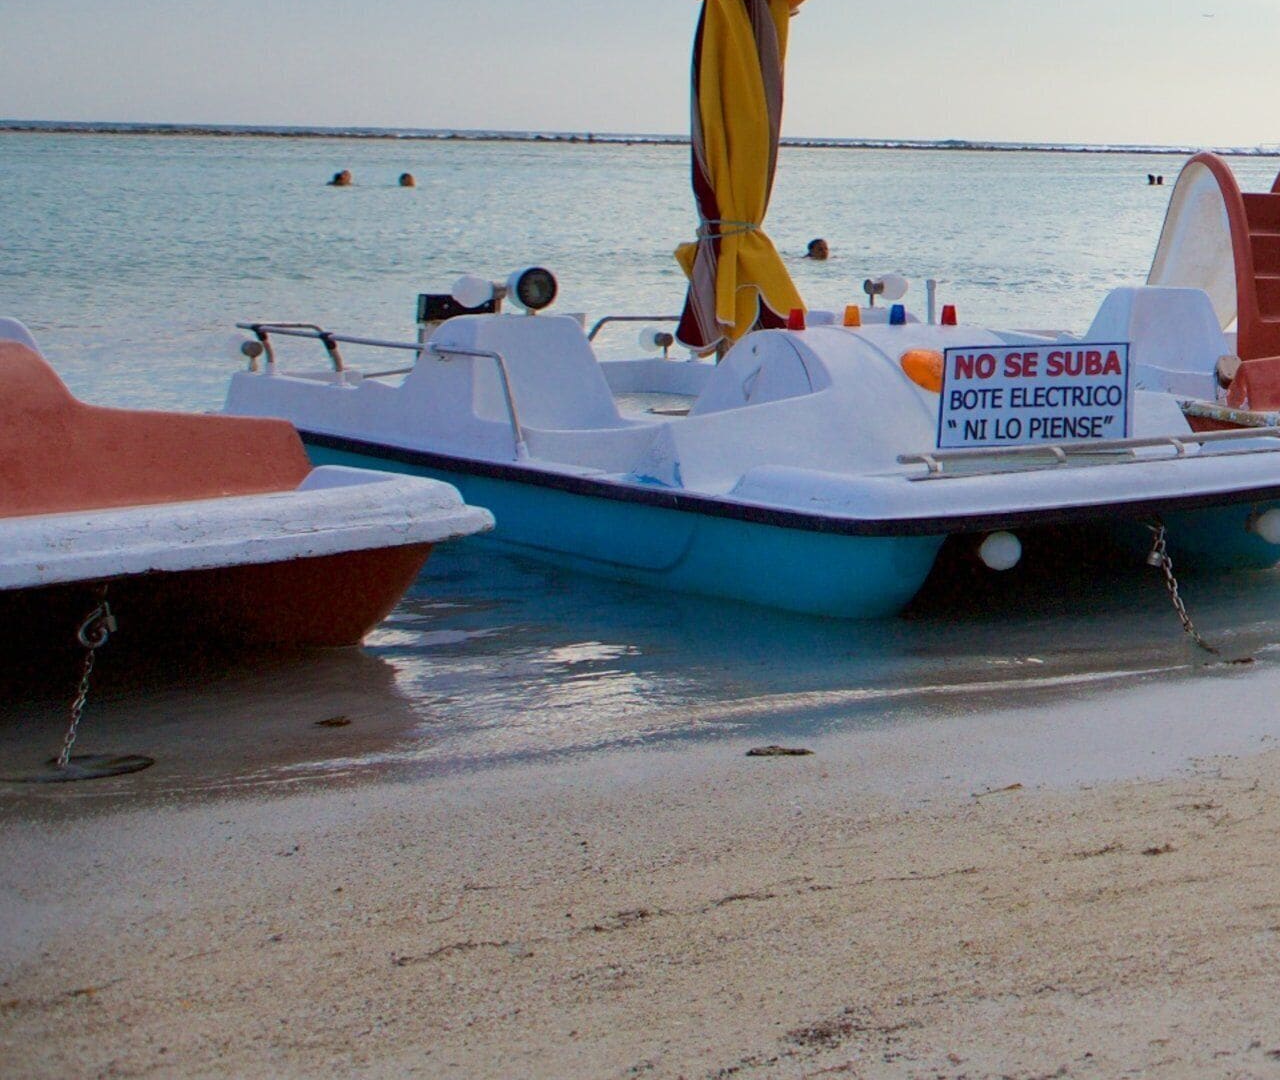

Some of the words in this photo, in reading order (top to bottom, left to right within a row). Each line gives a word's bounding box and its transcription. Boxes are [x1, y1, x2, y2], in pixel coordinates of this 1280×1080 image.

[954, 354, 996, 379] NO
[1004, 353, 1038, 377] SE
[1047, 350, 1121, 376] SUBA
[950, 388, 1003, 410] BOTE
[1010, 385, 1122, 408] ELECTRICO
[995, 418, 1021, 439] LO
